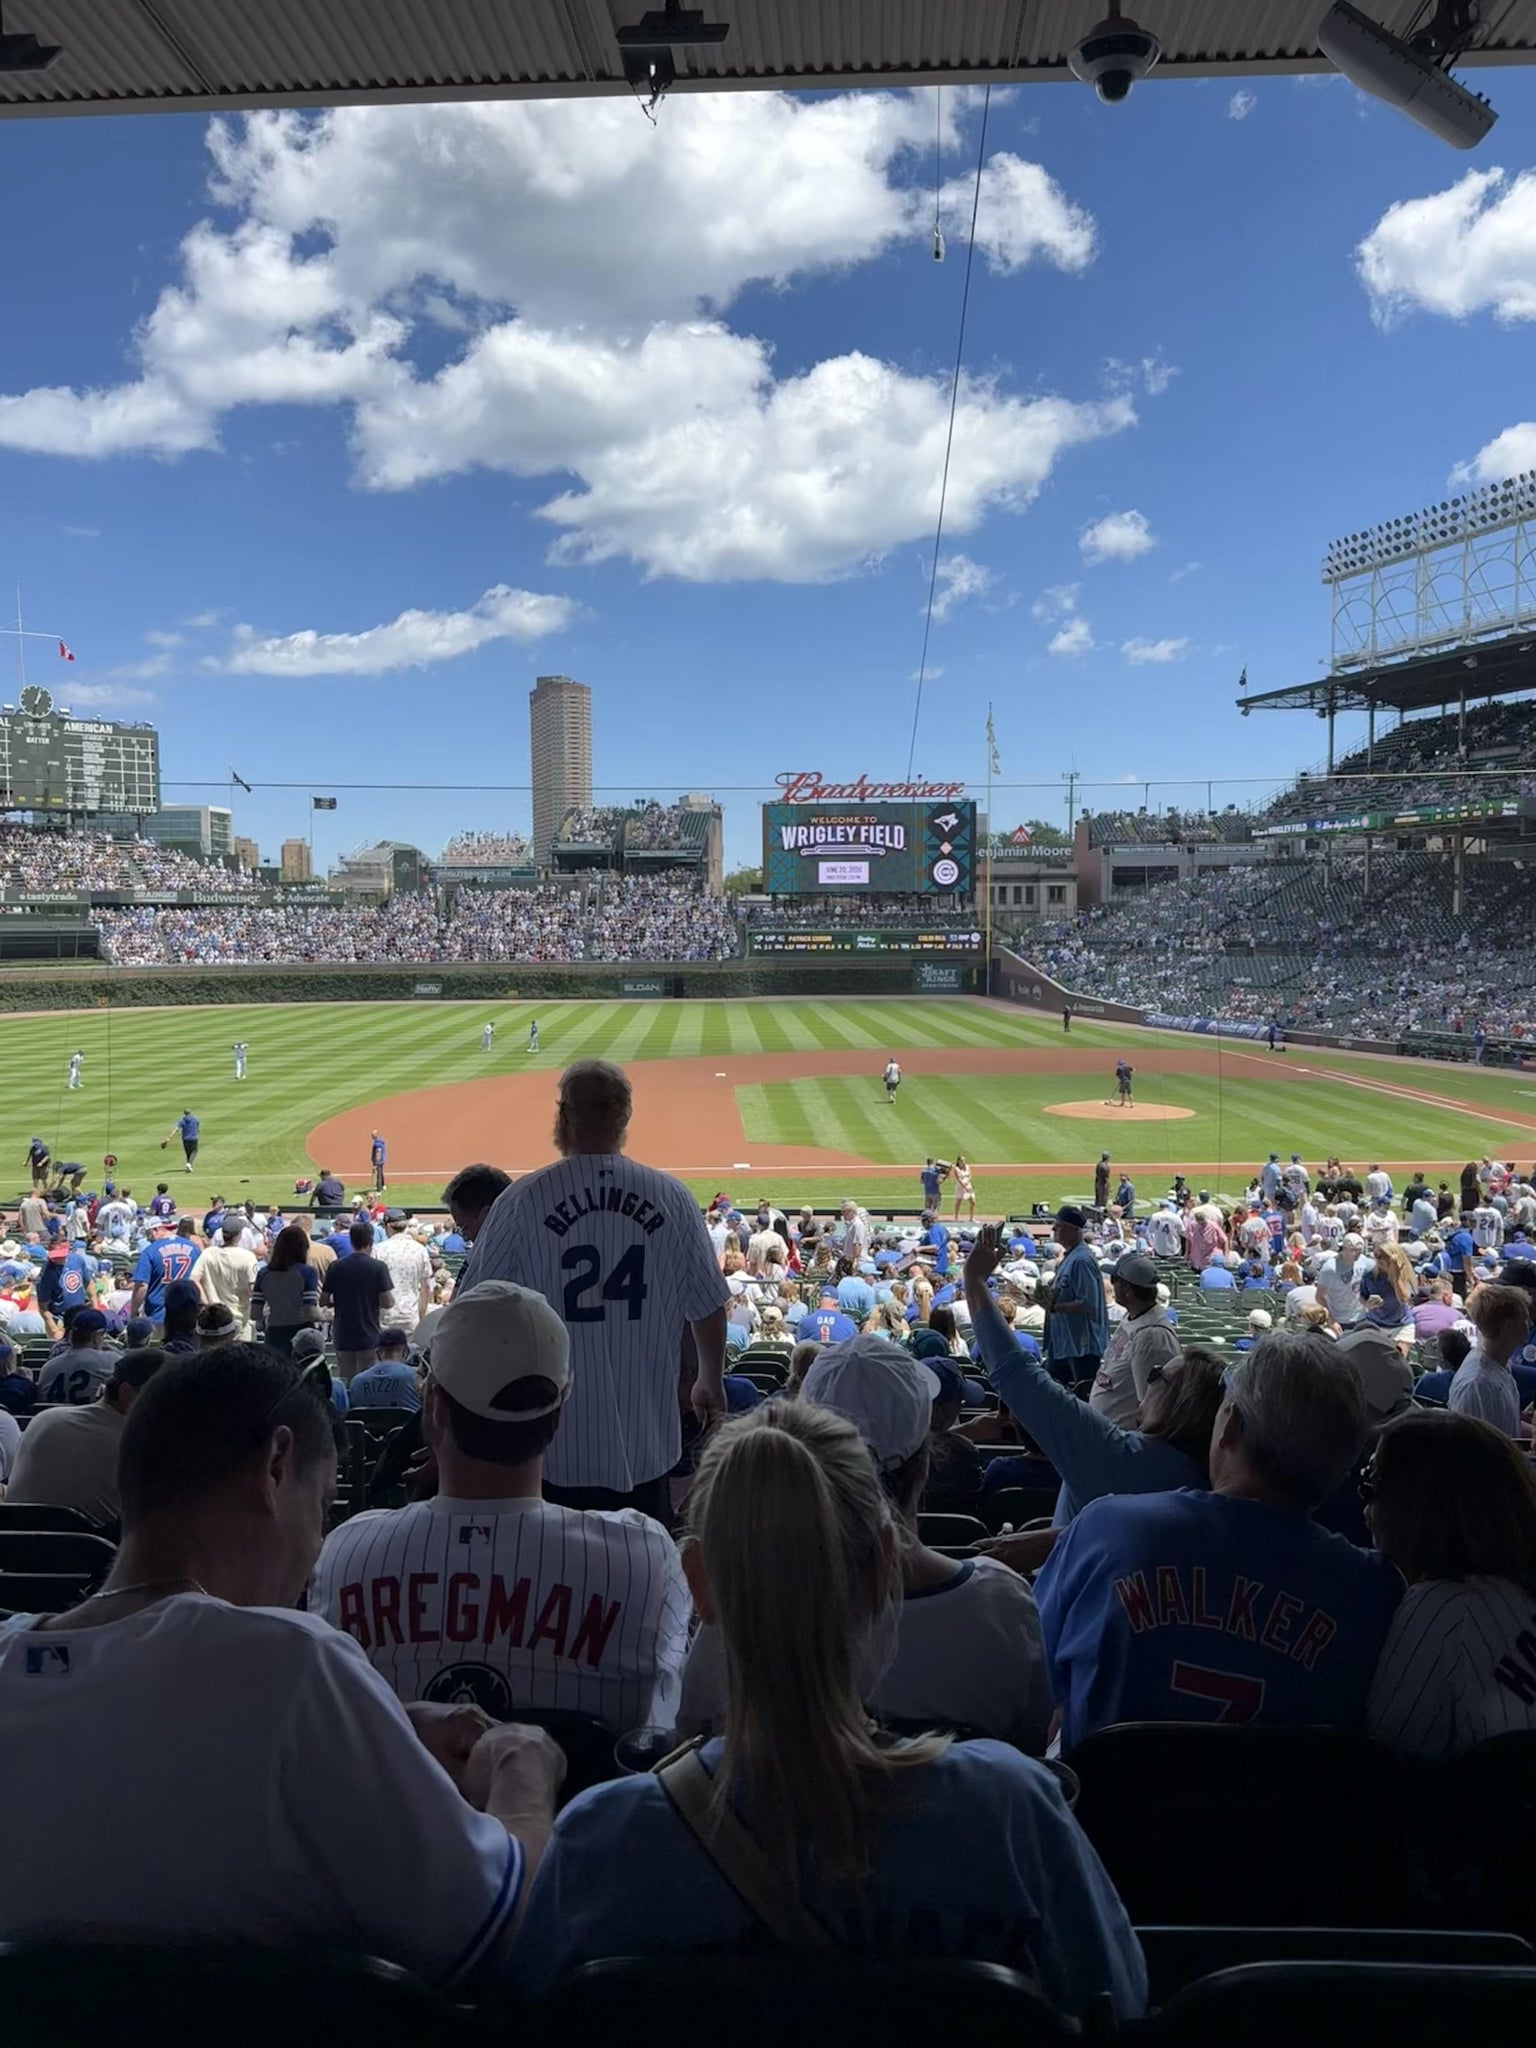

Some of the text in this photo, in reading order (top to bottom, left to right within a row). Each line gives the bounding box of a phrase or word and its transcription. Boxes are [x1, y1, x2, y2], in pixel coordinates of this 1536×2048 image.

[63, 721, 114, 734] AMERICAN
[774, 771, 965, 804] Budweiser
[810, 816, 860, 824] WELCOME
[781, 825, 905, 850] WRIGLEY FIELD
[975, 845, 1072, 859] enjamin Moore
[26, 892, 78, 902] tastytrade
[193, 891, 260, 903] Budweiser
[287, 893, 330, 903] Advocate
[623, 983, 660, 991] SLOAN
[543, 1186, 665, 1237] BELLINGER
[1162, 1223, 1170, 1235] 4
[1480, 1218, 1495, 1231] 24
[161, 1256, 192, 1285] 17
[561, 1244, 648, 1322] 24
[816, 1316, 835, 1325] DAD
[47, 1369, 91, 1405] 42
[363, 1378, 400, 1395] RIZZO
[339, 1572, 622, 1668] BREGMAN
[1113, 1565, 1338, 1671] WALKER
[1170, 1659, 1266, 1726] 7
